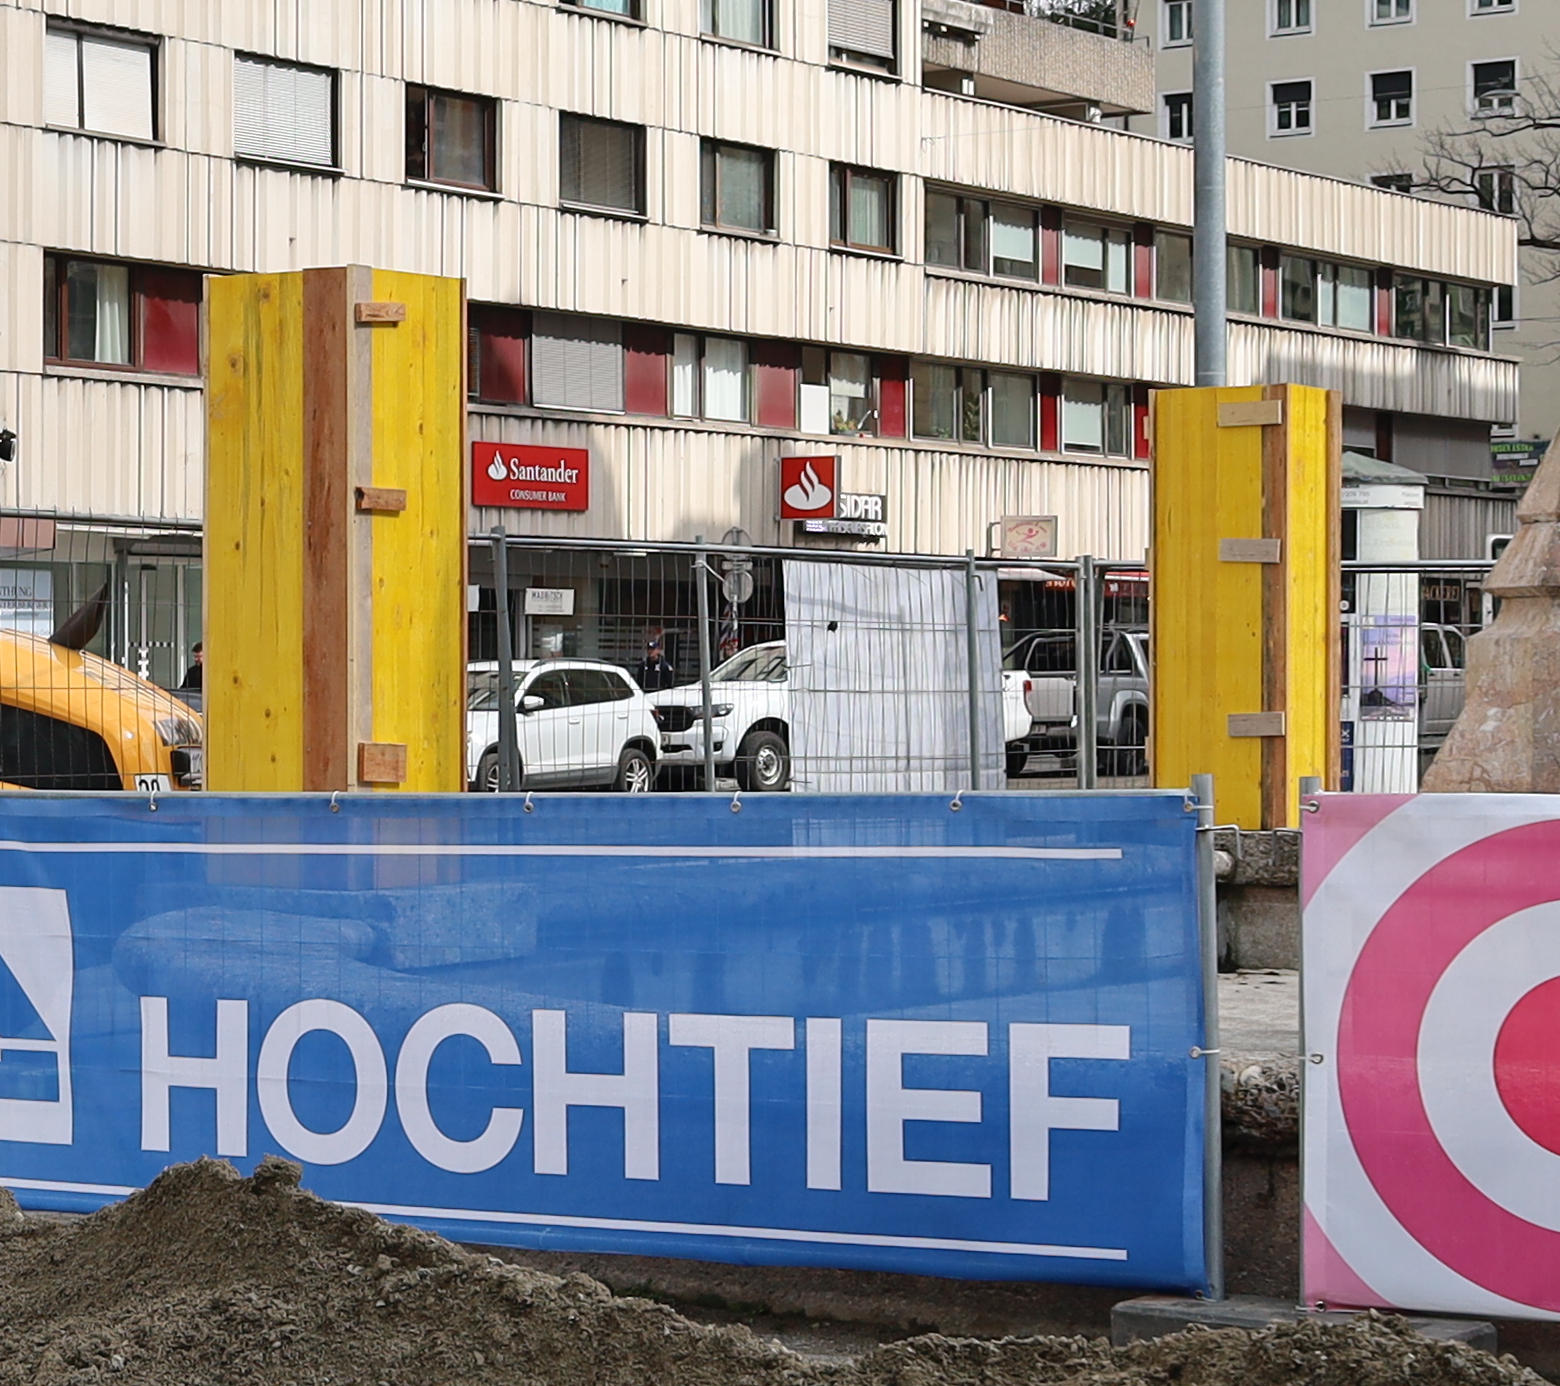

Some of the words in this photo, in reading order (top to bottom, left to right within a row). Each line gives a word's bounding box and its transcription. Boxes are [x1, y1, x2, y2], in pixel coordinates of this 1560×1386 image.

[509, 457, 579, 484] Santander
[509, 489, 547, 501] CONSUMER
[548, 490, 567, 502] BANK
[138, 995, 1133, 1201] HOCHTIEF
